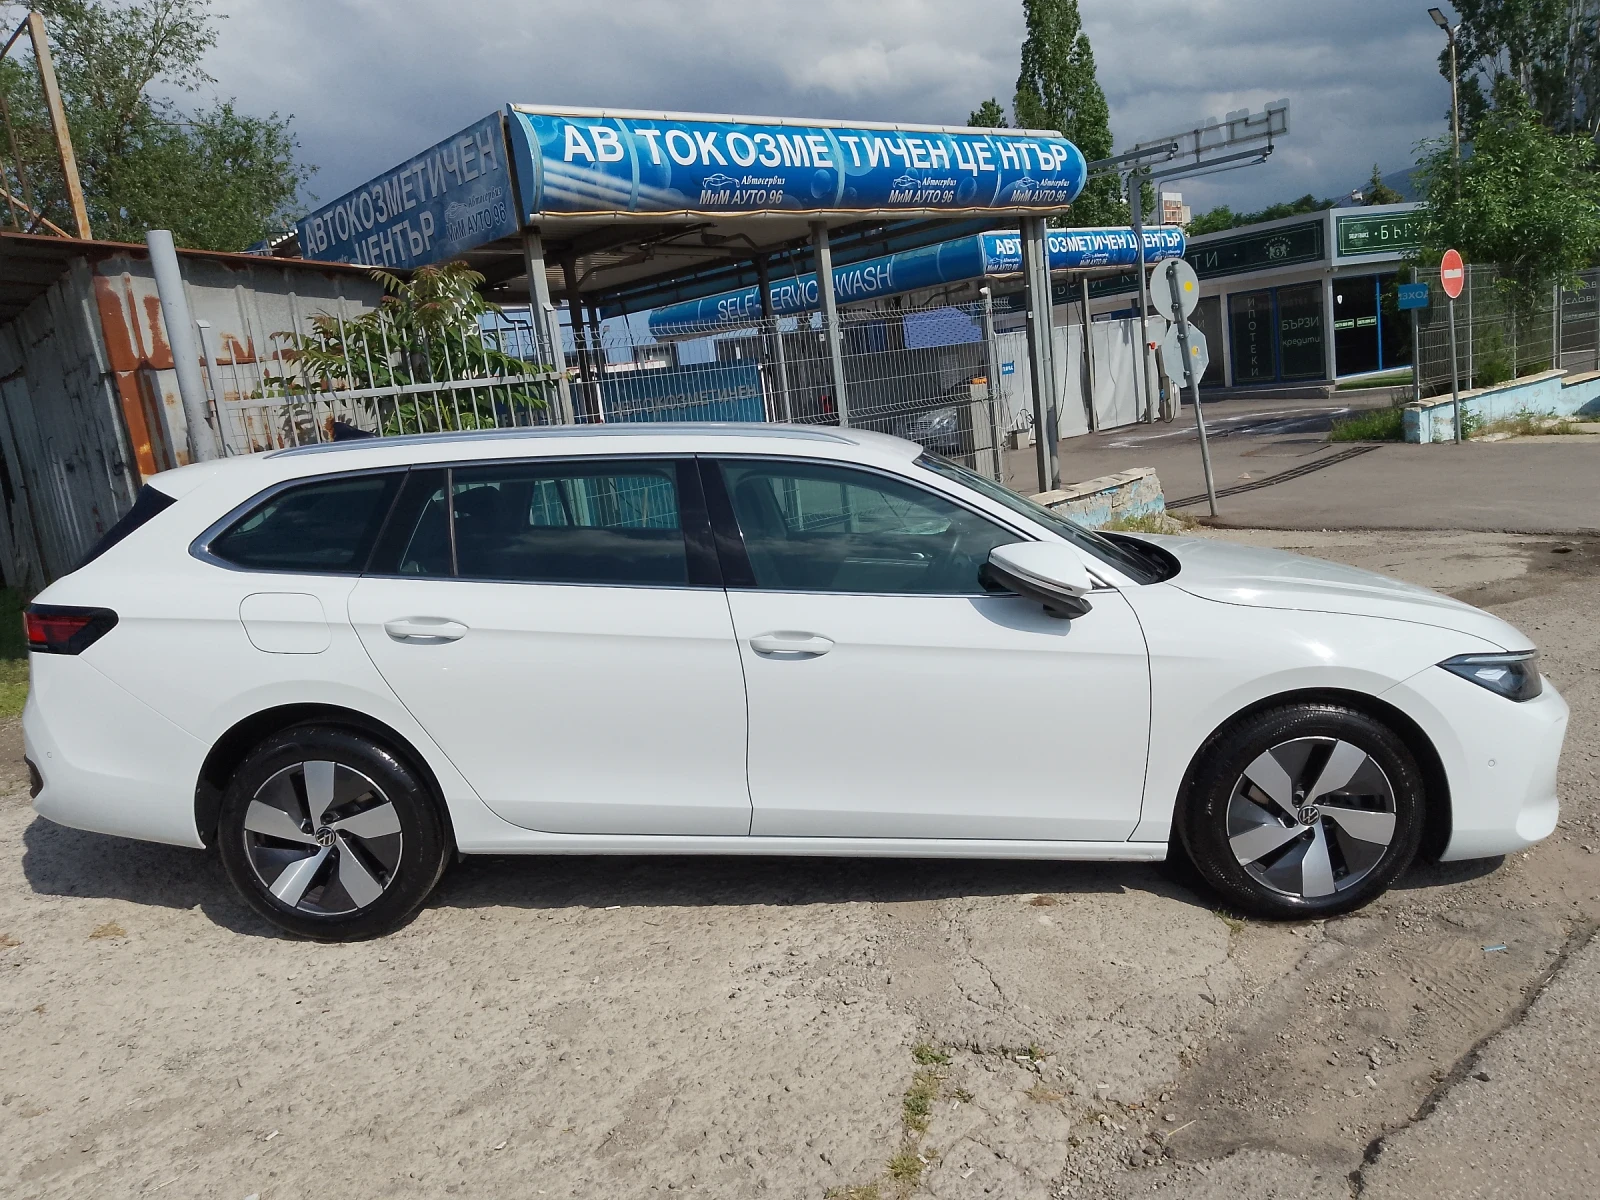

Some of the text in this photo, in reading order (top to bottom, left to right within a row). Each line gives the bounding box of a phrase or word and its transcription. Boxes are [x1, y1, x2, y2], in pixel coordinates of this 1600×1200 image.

[741, 175, 785, 186] Автосервиз
[922, 176, 957, 188] Автосервиз
[1040, 177, 1070, 188] Автосервиз
[304, 126, 499, 257] АВТОКОЗМЕТИЧЕН
[731, 190, 765, 205] АУТО
[768, 190, 783, 204] 96
[913, 190, 941, 203] АУТО
[941, 190, 953, 203] 96
[1031, 190, 1055, 202] АУТО
[1055, 190, 1067, 202] 96
[468, 209, 492, 235] АУТО
[494, 202, 507, 226] 96
[994, 234, 1126, 256] АВТОЗМЕТИЧЕН
[1282, 316, 1319, 331] БЪРЗИ
[1247, 298, 1259, 377] ИПОТЕКИ
